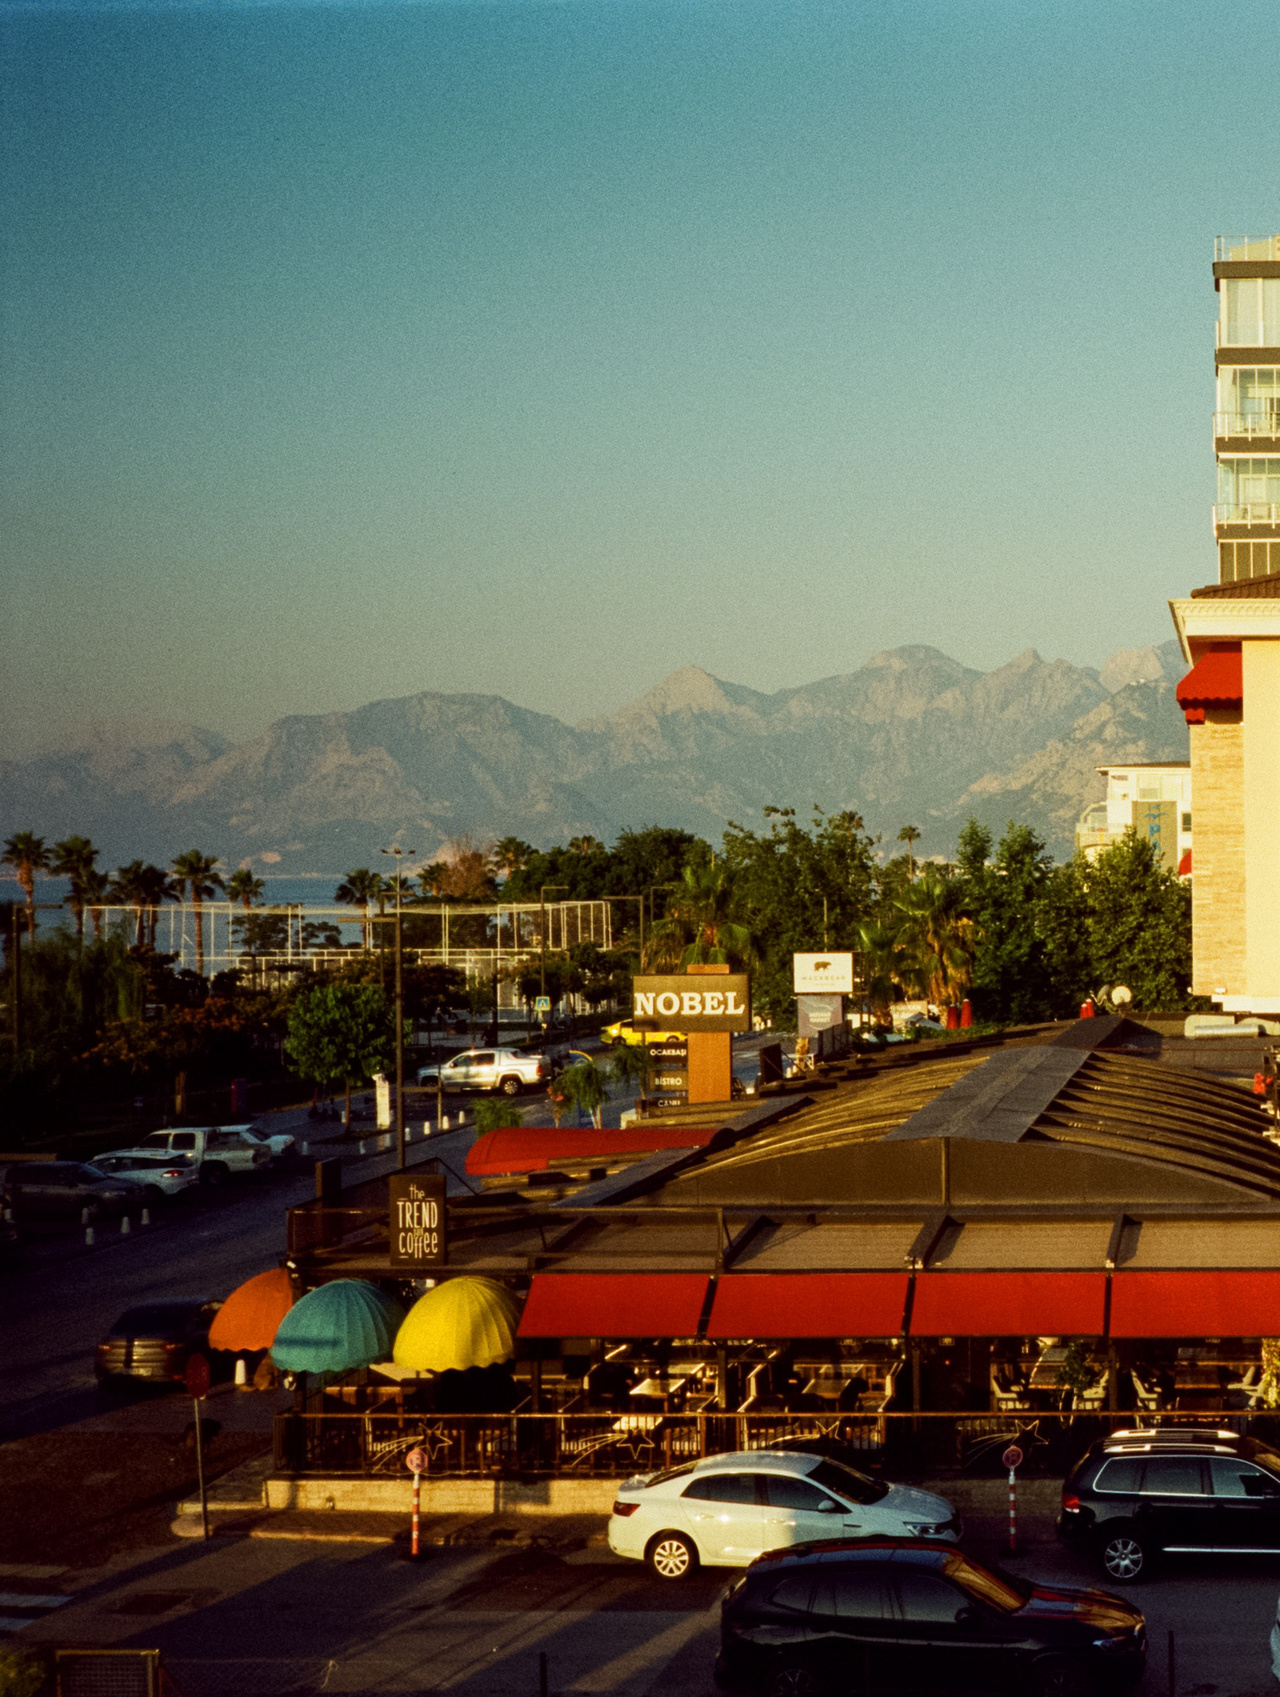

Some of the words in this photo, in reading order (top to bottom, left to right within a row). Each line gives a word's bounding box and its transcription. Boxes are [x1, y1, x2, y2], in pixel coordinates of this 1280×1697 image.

[634, 991, 745, 1016] NOBEL
[650, 1048, 687, 1057] OCAKBAŞI
[409, 1184, 425, 1199] the
[396, 1202, 439, 1228] TREND
